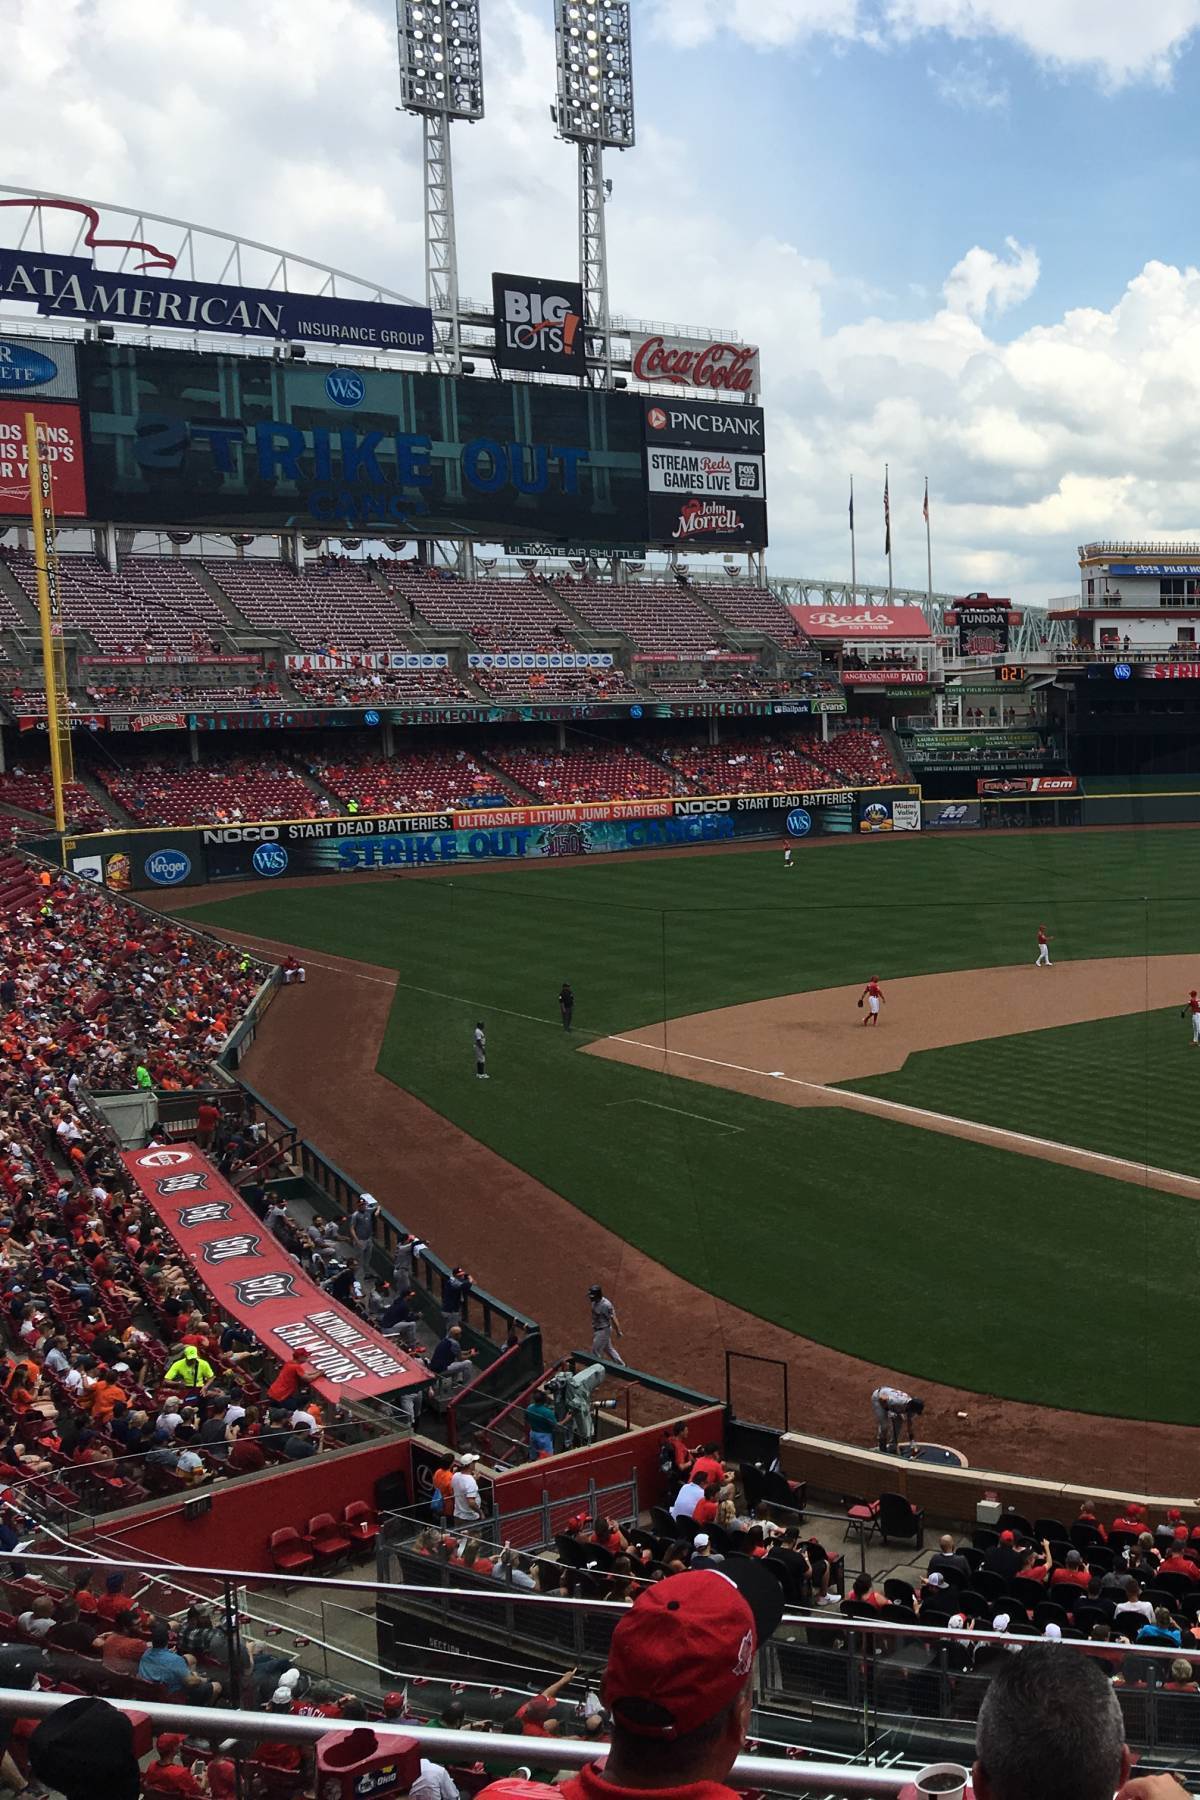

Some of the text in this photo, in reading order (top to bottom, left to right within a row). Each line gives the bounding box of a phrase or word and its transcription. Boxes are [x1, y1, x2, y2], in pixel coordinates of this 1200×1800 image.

[51, 274, 425, 346] AMERICAN INSURANCE GROUP
[504, 290, 571, 323] BIG
[328, 377, 362, 400] W&S
[0, 424, 73, 446] DS ANS,
[1, 443, 17, 459] IS
[462, 435, 589, 495] OUT
[652, 454, 732, 474] STREAM Reds
[738, 465, 755, 474] FOX
[664, 472, 730, 491] GAMES LIVE
[739, 478, 755, 487] GO
[698, 501, 726, 515] John
[672, 510, 744, 538] Morrell
[508, 546, 640, 559] ULTIMATE AIR SHUTTLE
[1163, 565, 1188, 573] PILOT
[809, 611, 894, 628] Reds
[961, 615, 1004, 623] TUNDRA
[901, 673, 923, 682] PATIO
[1001, 667, 1024, 680] 0:21
[400, 708, 490, 724] STRIKEOUT
[782, 704, 808, 714] Ballpark
[820, 703, 844, 712] Evans
[675, 791, 856, 815] NOCO START DEAD BATTERIES.
[458, 803, 671, 828] ULTRASAFE LITHIUM JUMP STARTERS.
[788, 816, 810, 830] W&S
[203, 816, 452, 844] NOCO START DEAD BATTERIES.
[339, 835, 458, 868] STRIKE
[467, 830, 531, 859] OUT
[151, 856, 185, 879] Kroger
[255, 852, 286, 869] W&S
[213, 1236, 251, 1259] 1970
[241, 1274, 286, 1300] 1972
[272, 1322, 367, 1384] CHAMPIONS
[306, 1311, 406, 1379] NATIONAL LEAGUE
[377, 1772, 397, 1786] OHIO
